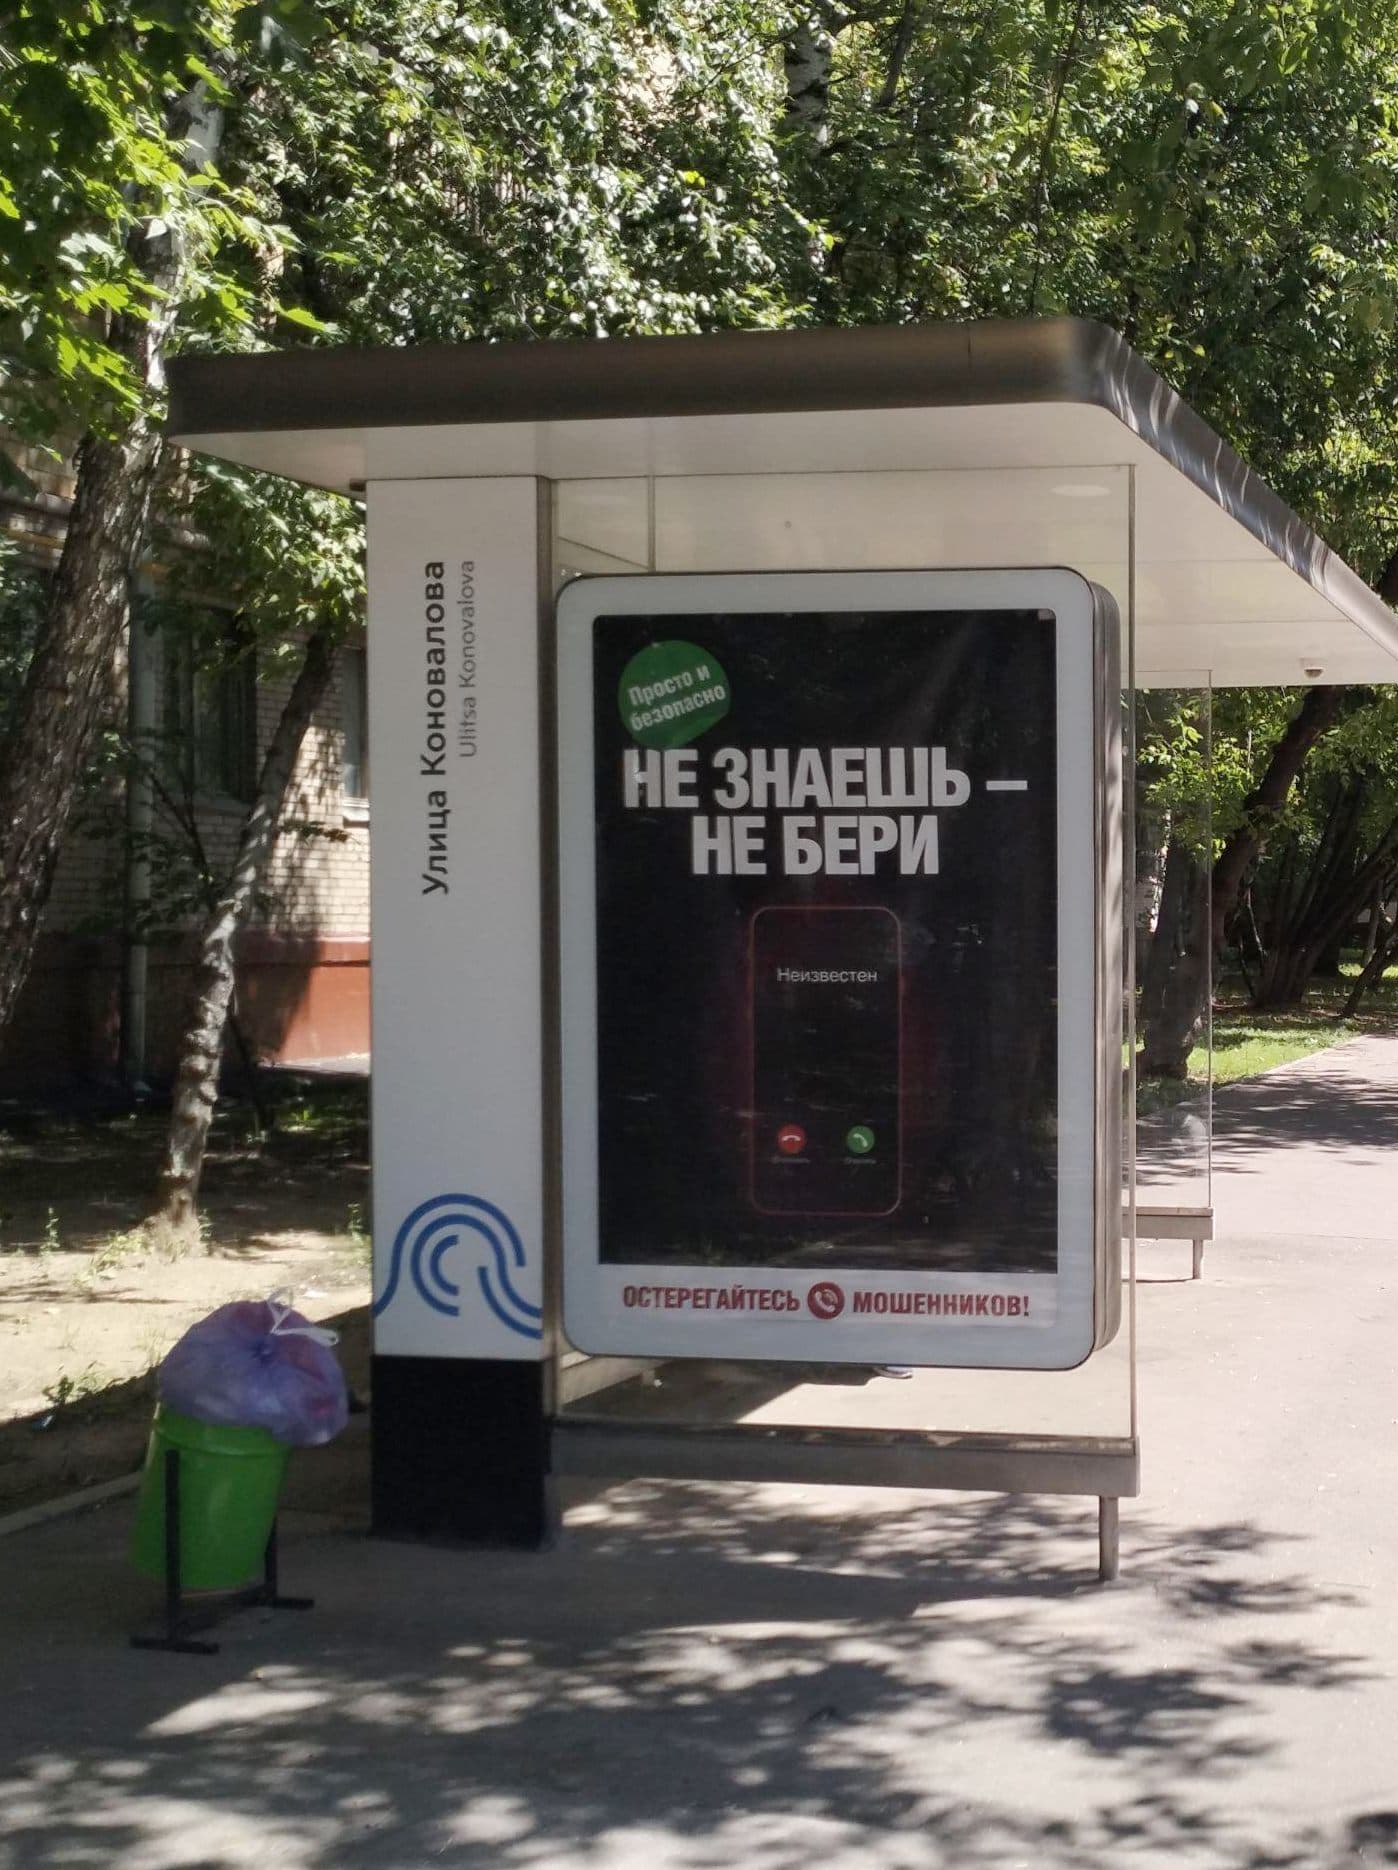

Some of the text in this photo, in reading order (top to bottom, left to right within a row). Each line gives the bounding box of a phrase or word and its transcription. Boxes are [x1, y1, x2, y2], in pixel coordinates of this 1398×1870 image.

[456, 561, 477, 757] Ulitsa Konovalova
[629, 664, 711, 706] Просто и
[420, 561, 451, 895] Улица Коновалова
[630, 685, 726, 731] безопасно
[623, 748, 699, 808] НЕ
[711, 746, 971, 809] ЗНАЕШЬ
[691, 814, 940, 875] НЕ БЕРИ
[776, 967, 878, 983] Неизвестен
[623, 1284, 1030, 1318] ОСТЕРЕГАЙТЕСЬ МОШЕННИКОВ!
